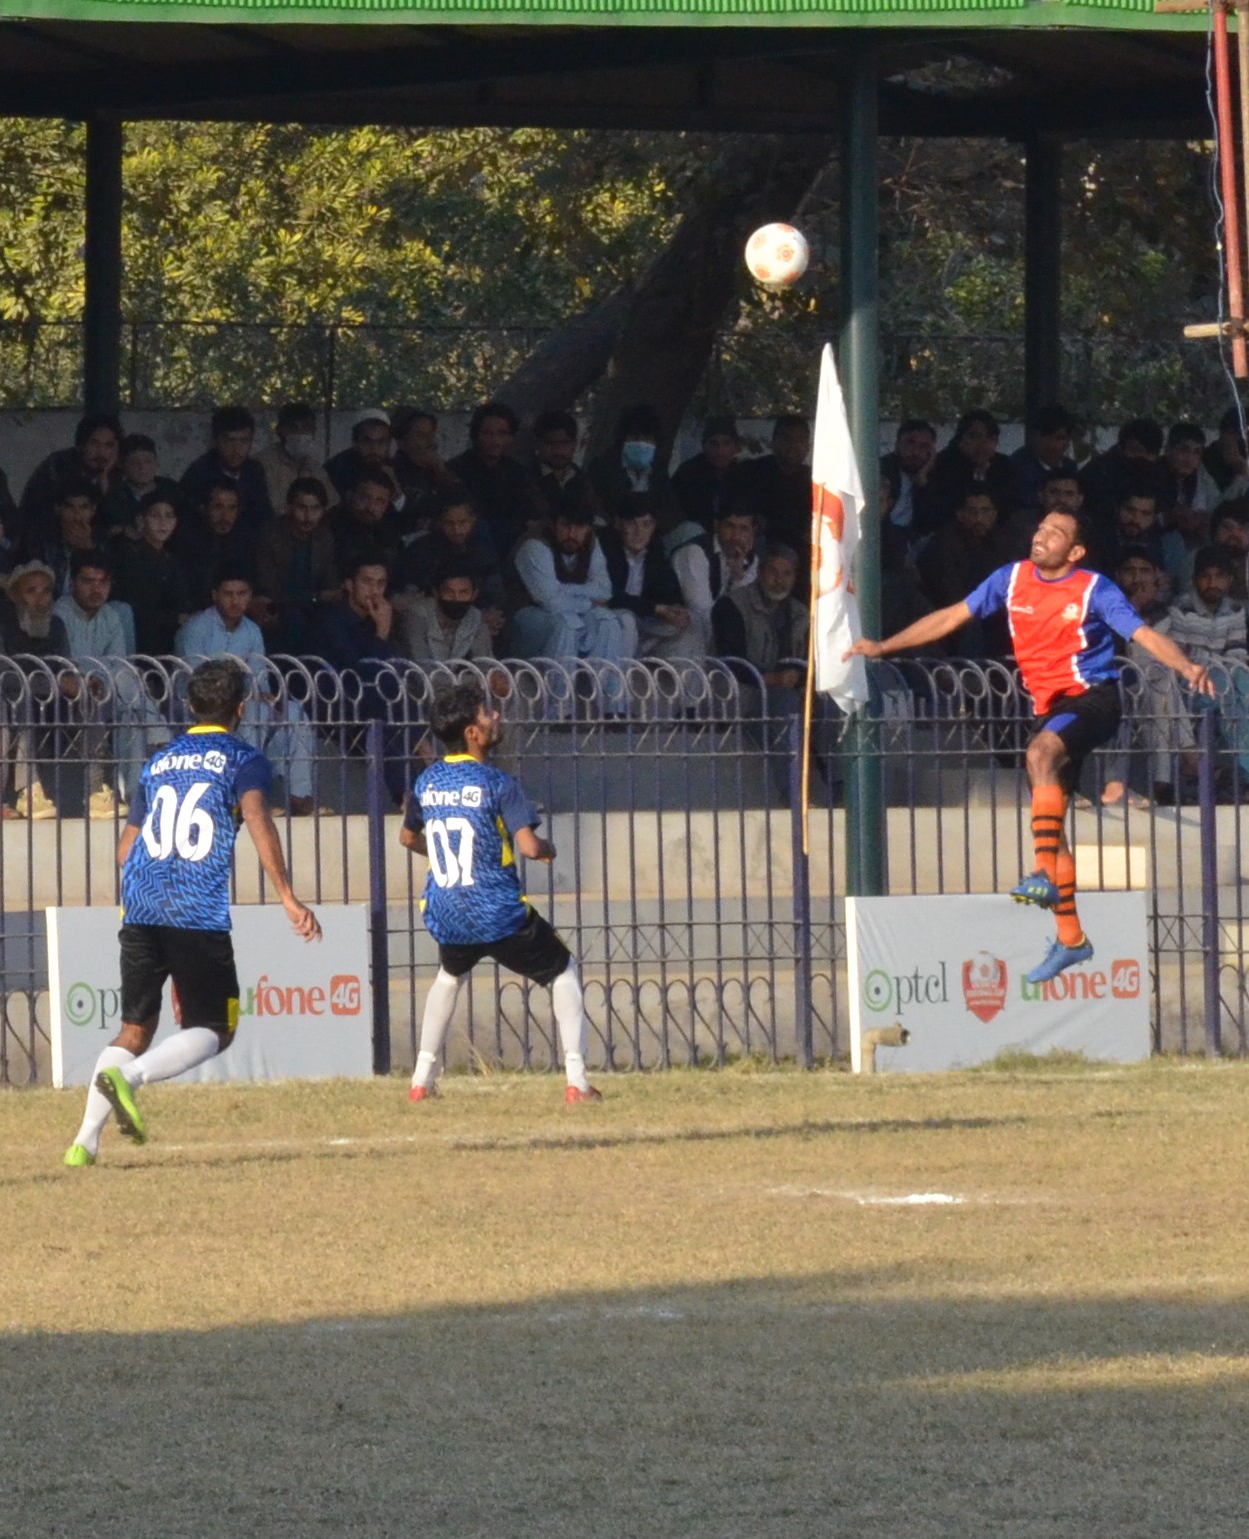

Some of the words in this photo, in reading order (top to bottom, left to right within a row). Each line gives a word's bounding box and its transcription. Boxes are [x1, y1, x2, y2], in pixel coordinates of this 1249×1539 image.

[204, 752, 225, 771] 4G
[462, 788, 480, 805] 4G
[142, 782, 212, 861] 06
[426, 817, 475, 888] 07
[331, 979, 360, 1012] 4G
[893, 961, 950, 1015] ptcl
[1112, 963, 1139, 995] 4G
